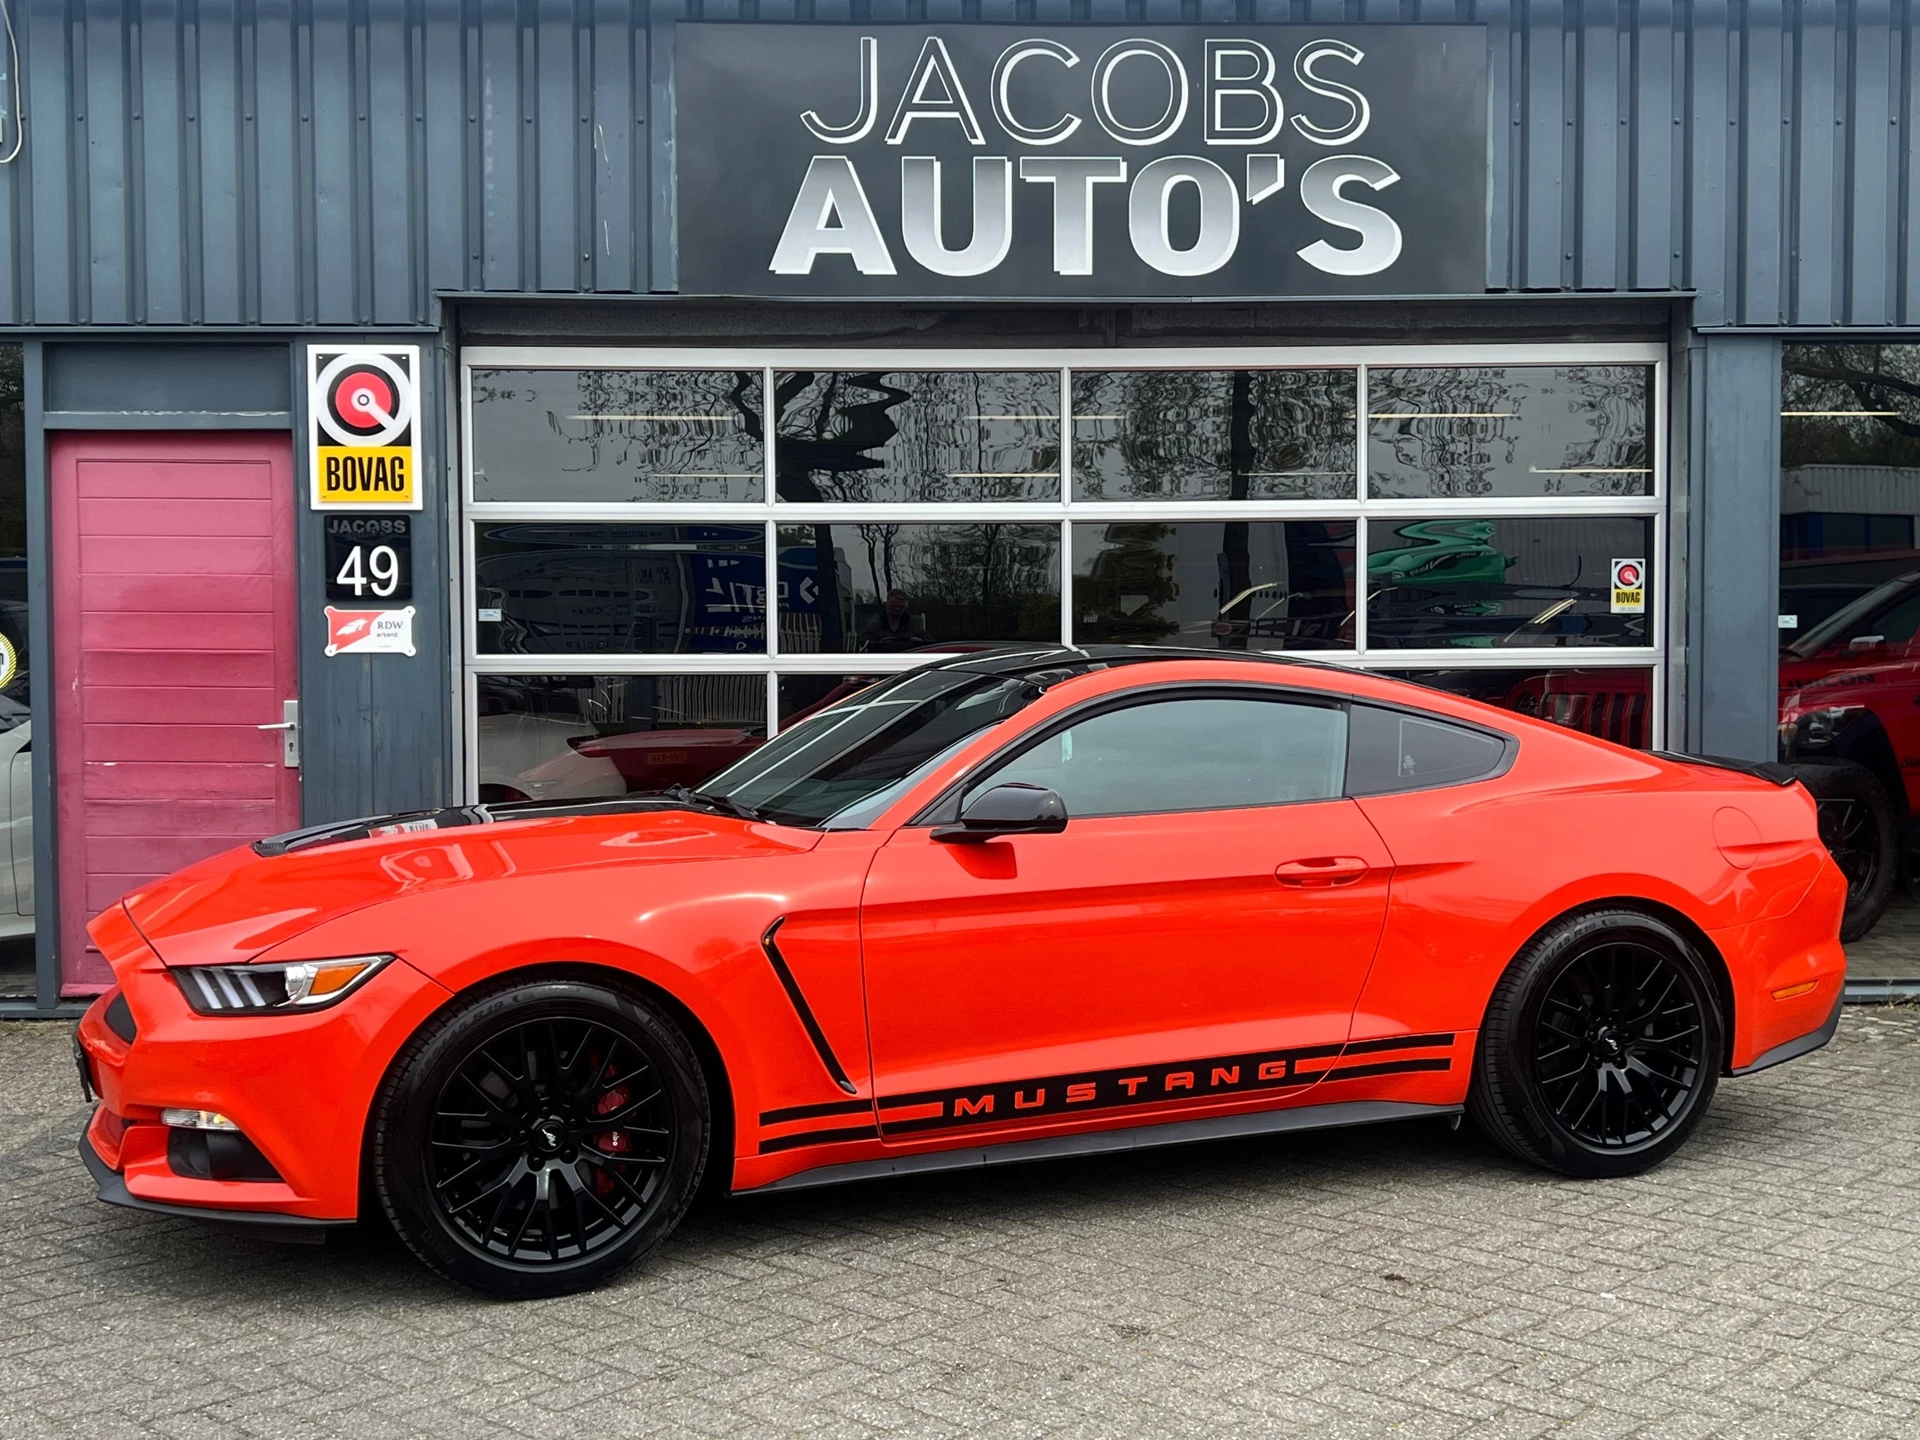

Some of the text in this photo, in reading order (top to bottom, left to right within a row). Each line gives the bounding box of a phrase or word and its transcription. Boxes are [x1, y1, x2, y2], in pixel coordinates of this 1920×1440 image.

[801, 37, 1371, 146] JACOBS
[769, 155, 1403, 277] AUTO'S
[326, 456, 404, 491] BOVAG
[327, 520, 406, 534] JACOBS
[336, 545, 398, 596] 49
[1616, 592, 1640, 603] BOVAG
[377, 621, 403, 629] RDW
[954, 1060, 1288, 1117] MUSTANG
